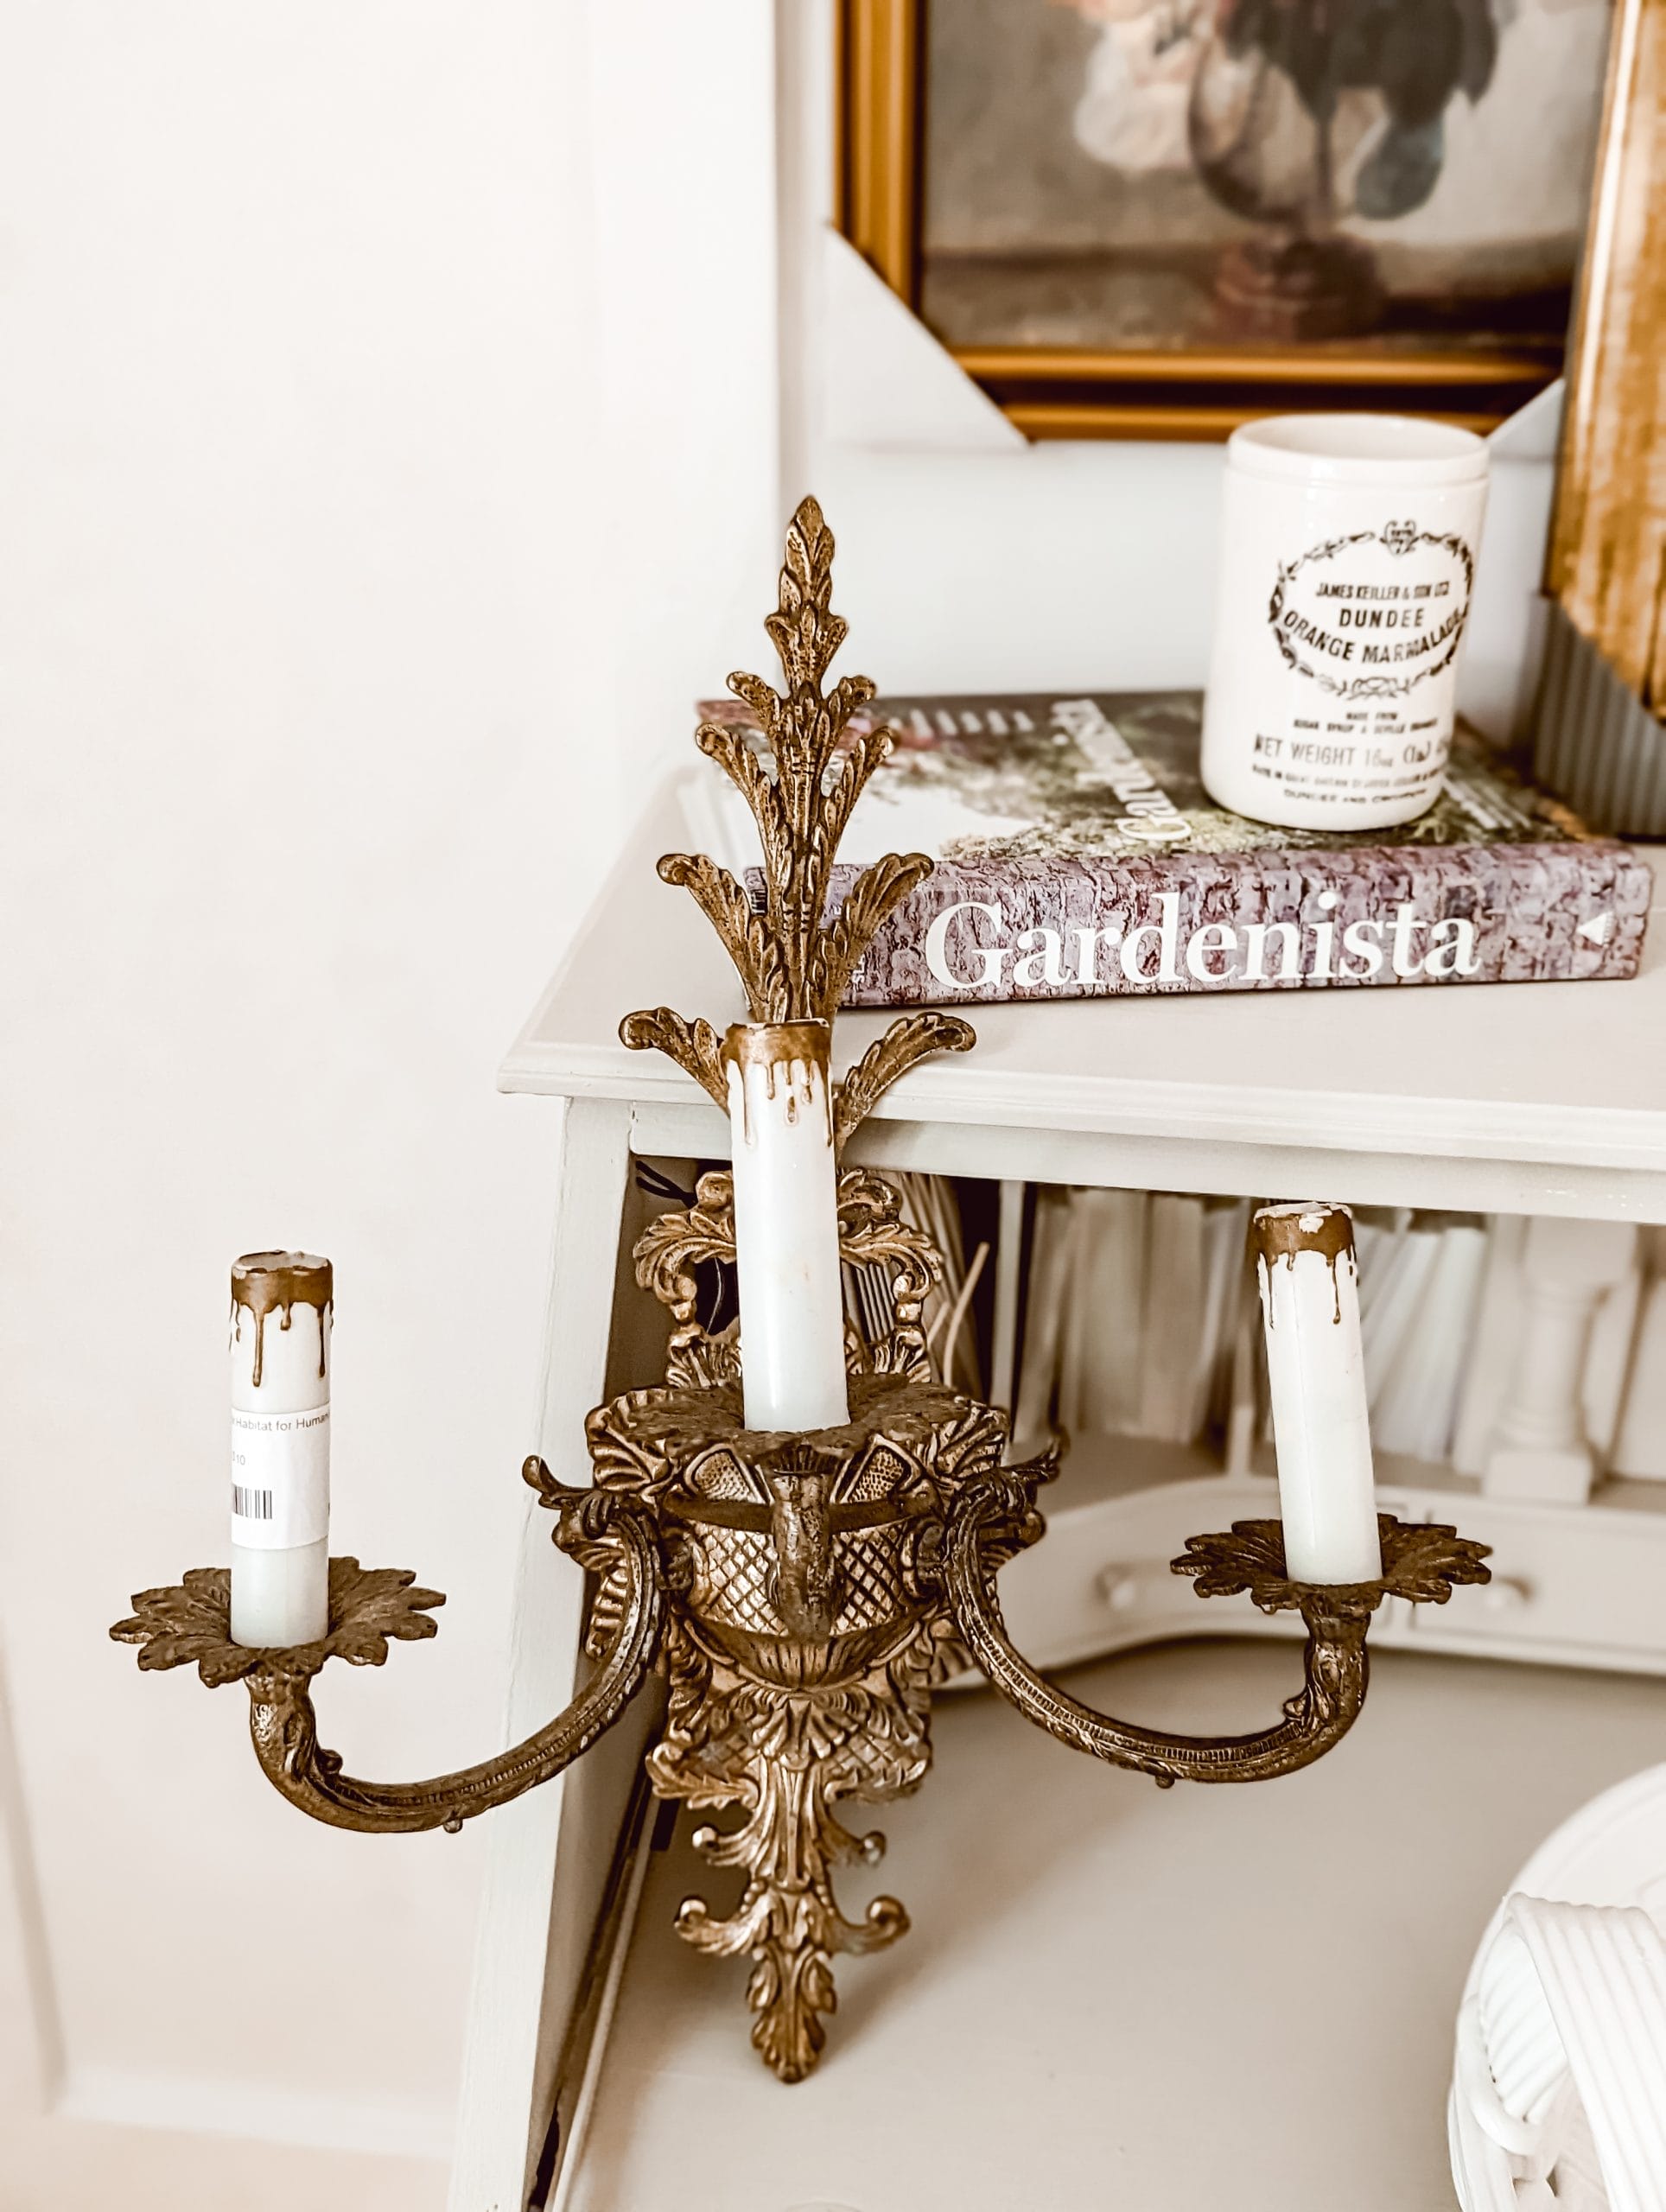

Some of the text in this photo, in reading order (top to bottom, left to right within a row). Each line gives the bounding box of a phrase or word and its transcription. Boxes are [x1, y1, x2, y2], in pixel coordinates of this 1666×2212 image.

[1316, 582, 1353, 598] JAMES
[1339, 607, 1425, 627] DUNDEE
[1284, 607, 1463, 664] ORANGE MARMALADE
[1255, 733, 1283, 759] NET
[1291, 742, 1356, 766] WEIGHT
[925, 891, 1481, 990] Gardenista
[235, 1418, 272, 1431] Habitat
[277, 1421, 291, 1431] for
